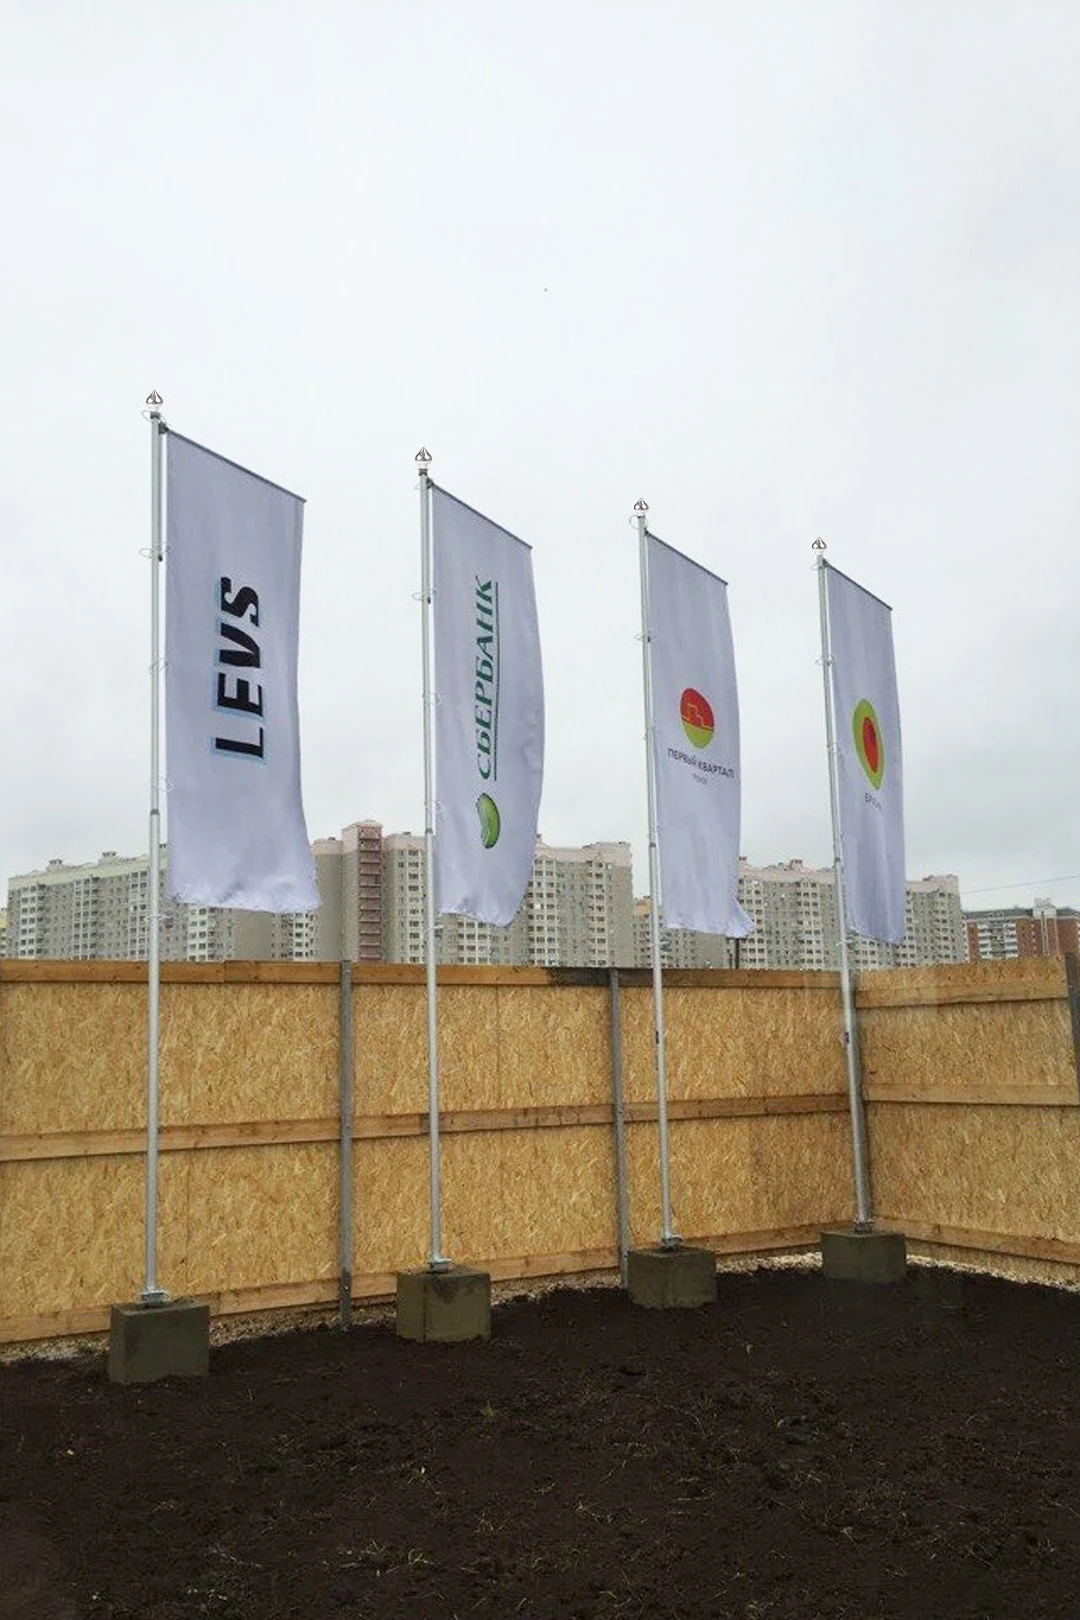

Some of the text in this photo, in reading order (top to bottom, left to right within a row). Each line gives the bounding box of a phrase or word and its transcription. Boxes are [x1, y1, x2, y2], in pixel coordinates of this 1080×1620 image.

[214, 576, 264, 759] LEVS
[475, 575, 494, 780] СБЕРБАНК
[698, 760, 735, 779] КВАРТАЛ
